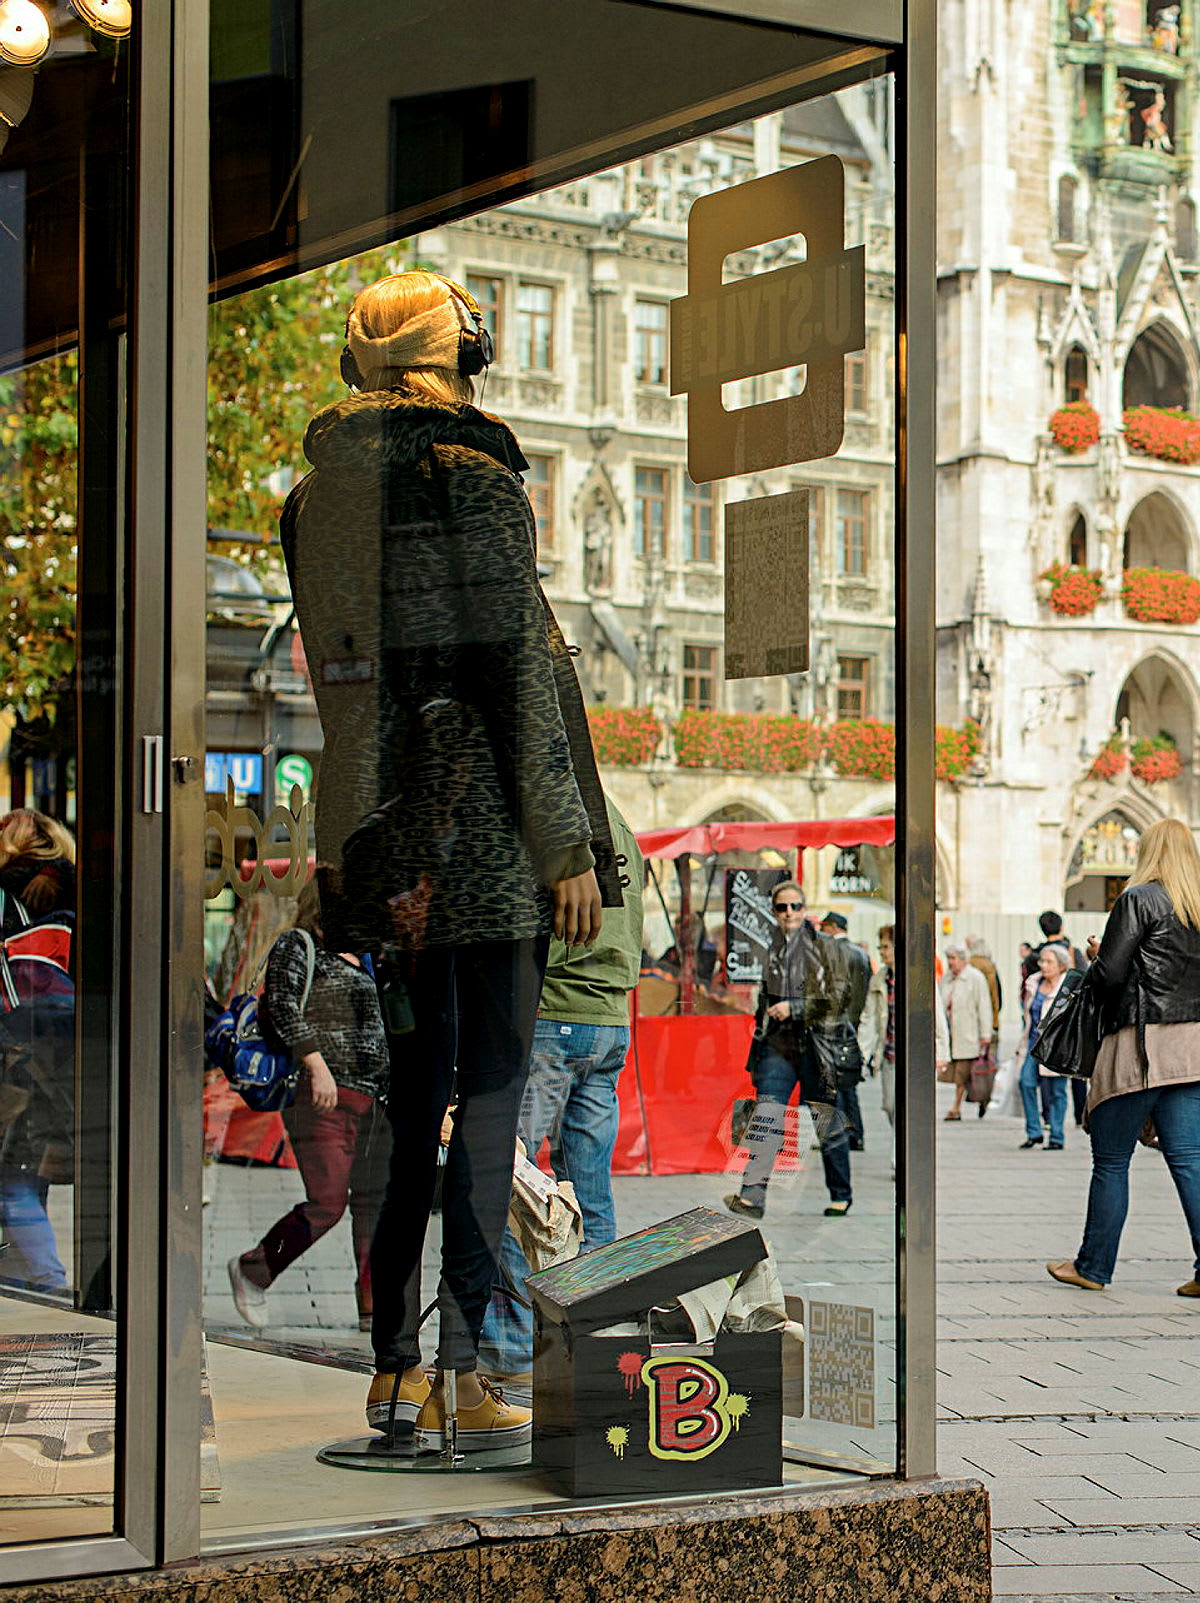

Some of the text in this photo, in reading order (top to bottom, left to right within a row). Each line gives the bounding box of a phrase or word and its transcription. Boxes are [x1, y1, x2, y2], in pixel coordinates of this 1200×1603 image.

[232, 758, 254, 788] U
[281, 759, 306, 791] S
[645, 1358, 730, 1459] B
